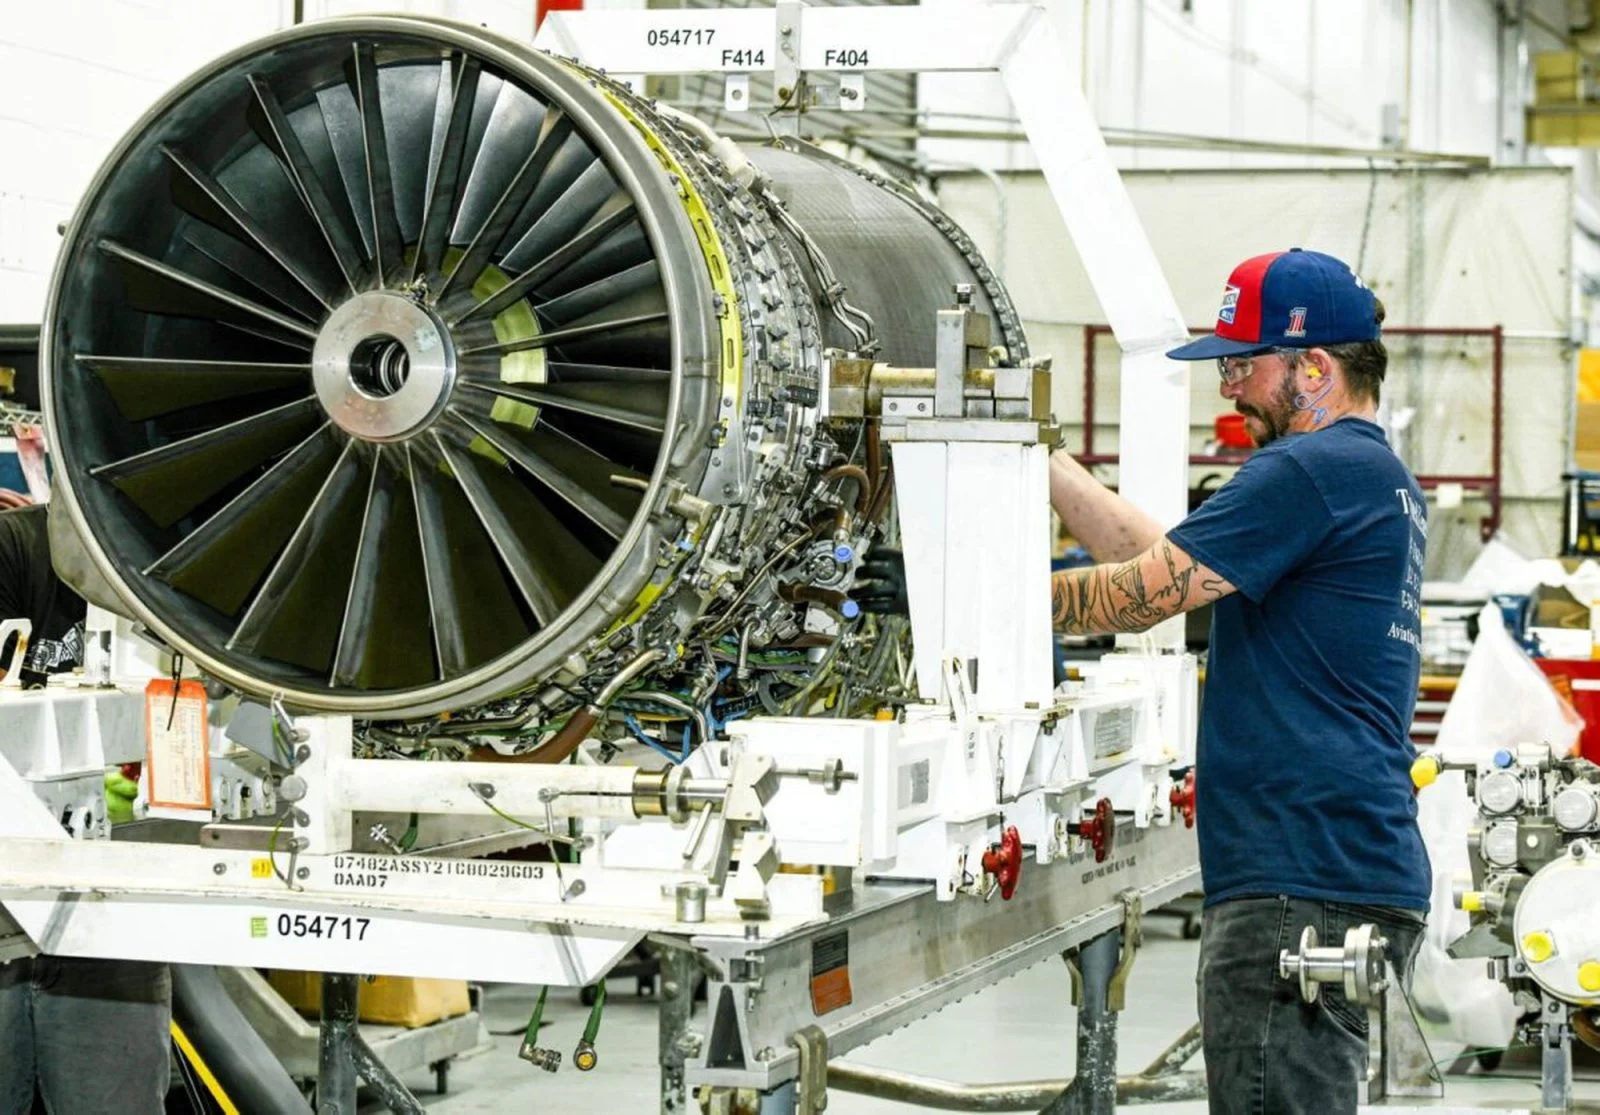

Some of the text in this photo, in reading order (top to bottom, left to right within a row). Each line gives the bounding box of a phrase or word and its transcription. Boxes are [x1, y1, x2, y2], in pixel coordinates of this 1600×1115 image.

[647, 29, 716, 46] 054717
[721, 49, 765, 66] F414
[824, 49, 869, 66] F404
[277, 913, 371, 941] 054717
